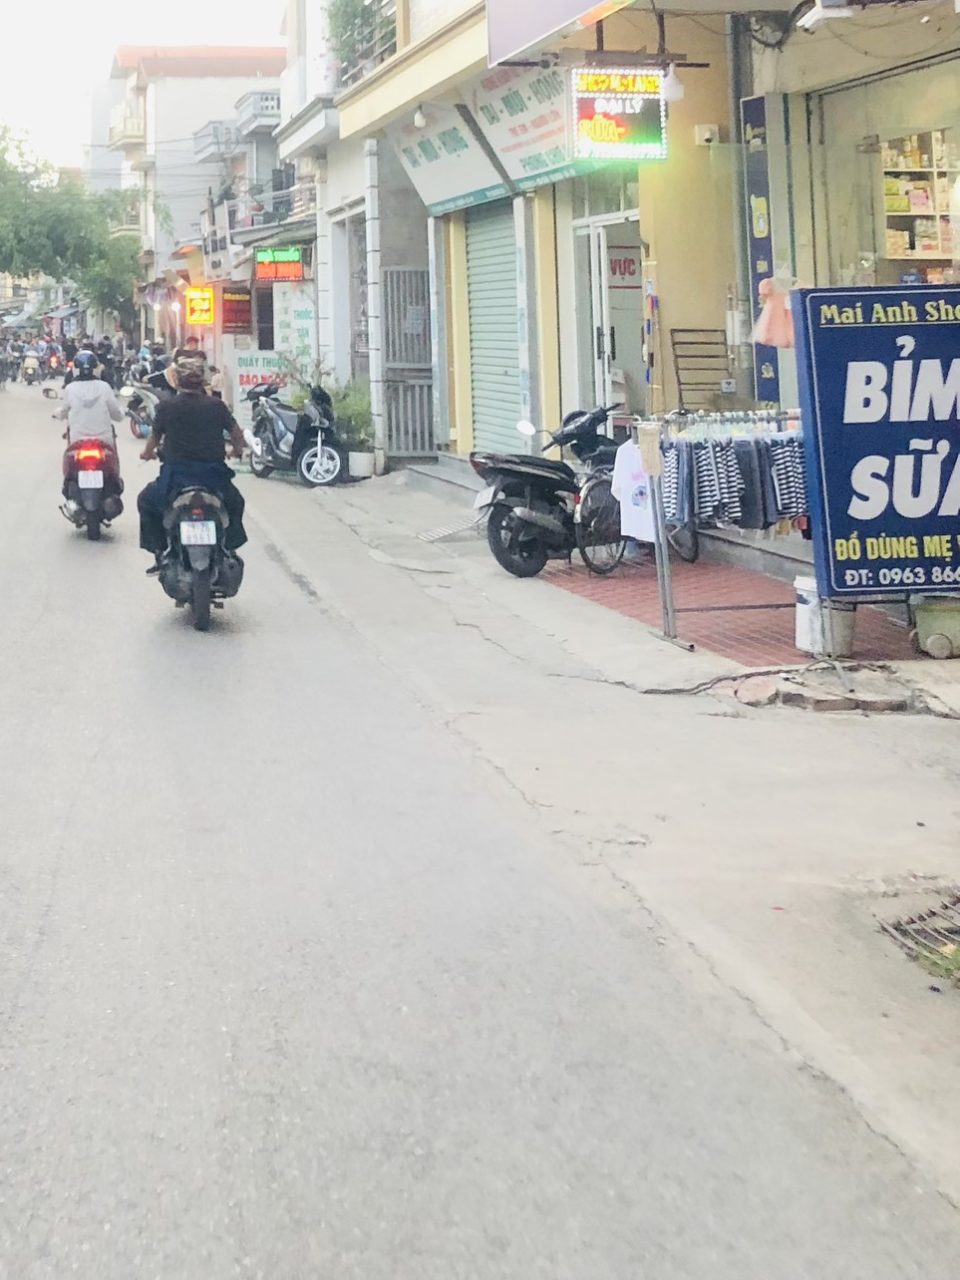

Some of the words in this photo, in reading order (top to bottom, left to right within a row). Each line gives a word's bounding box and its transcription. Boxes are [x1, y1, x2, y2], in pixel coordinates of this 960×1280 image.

[820, 302, 863, 324] Mai
[871, 301, 918, 323] Anh
[843, 335, 960, 423] BỈM
[866, 532, 919, 559] DÙNG
[923, 535, 953, 561] MẸ
[845, 569, 873, 585] ĐT:
[879, 567, 925, 584] 0963
